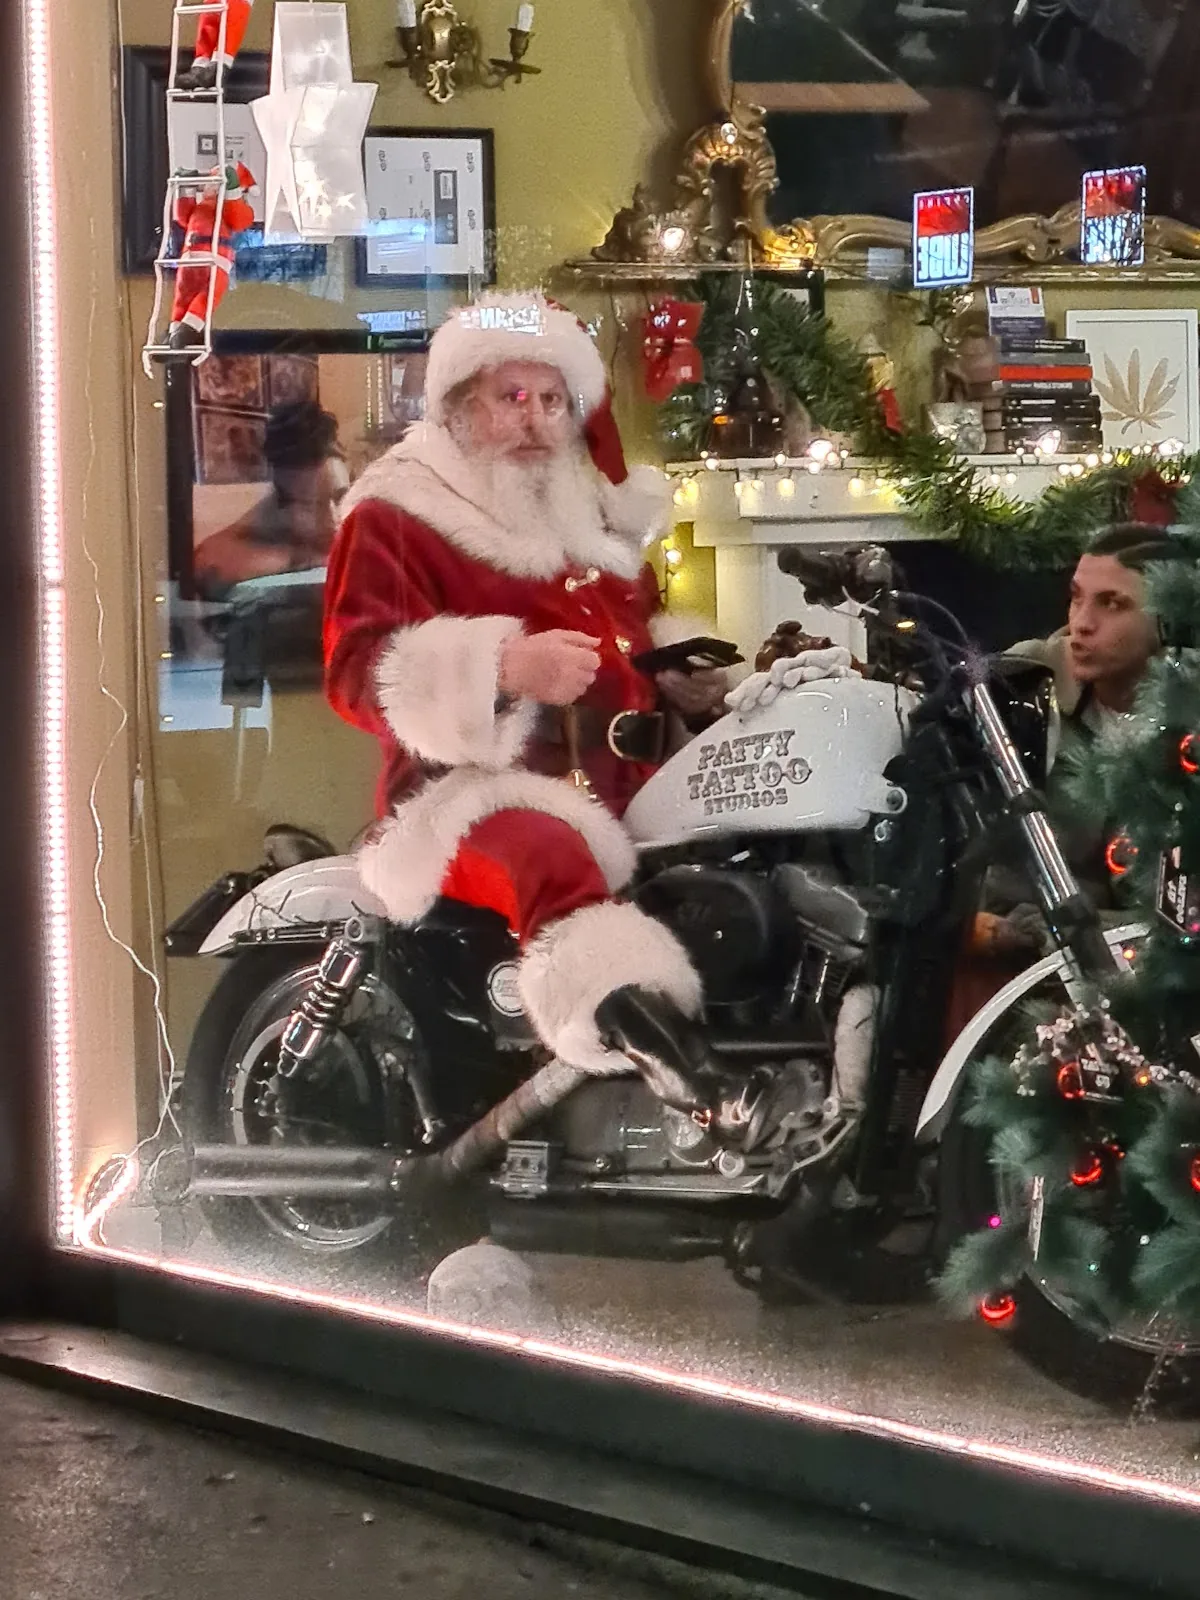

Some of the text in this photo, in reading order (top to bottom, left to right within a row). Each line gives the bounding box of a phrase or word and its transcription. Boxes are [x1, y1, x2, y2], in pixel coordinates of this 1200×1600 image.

[698, 730, 796, 771] PATTY
[687, 757, 813, 800] TATTOO
[704, 788, 788, 816] STUDIOS
